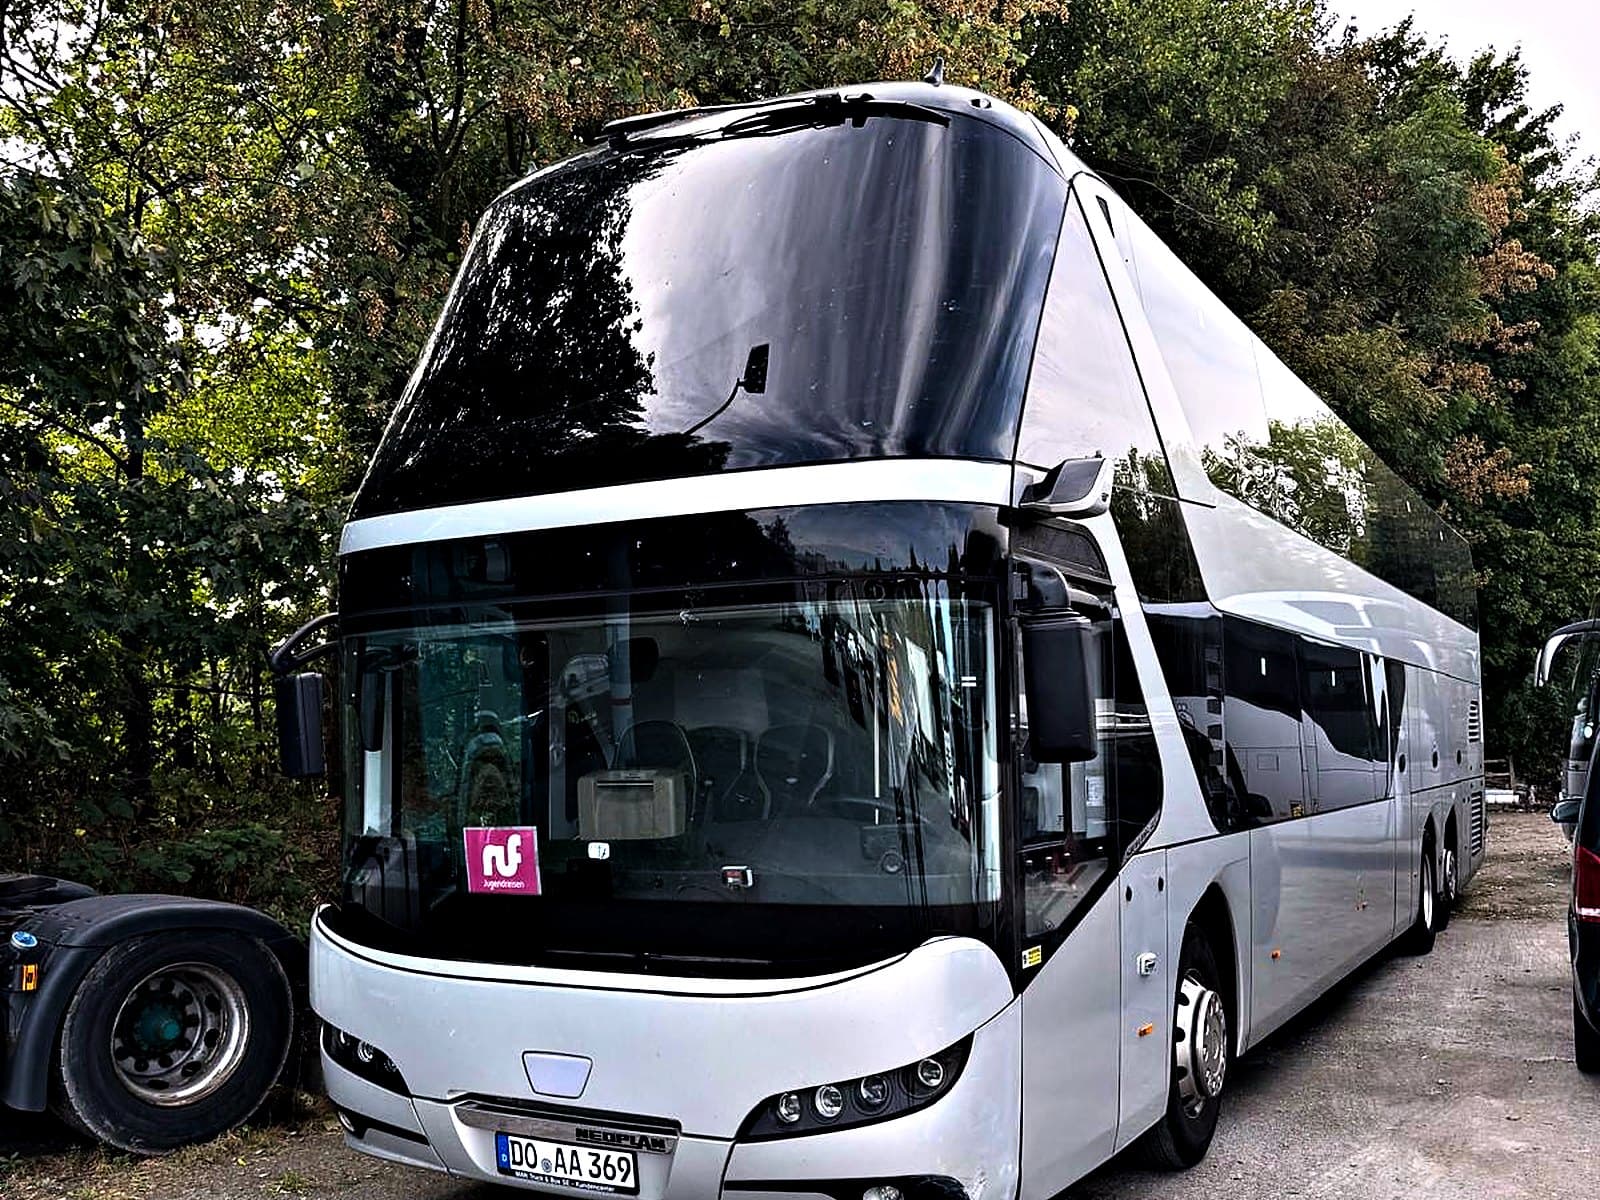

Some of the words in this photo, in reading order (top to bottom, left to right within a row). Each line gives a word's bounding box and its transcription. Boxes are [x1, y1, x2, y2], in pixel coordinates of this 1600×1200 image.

[576, 1127, 666, 1153] NEOPLAN
[510, 1140, 538, 1169] DO
[554, 1147, 583, 1177] AA
[587, 1152, 631, 1183] 369
